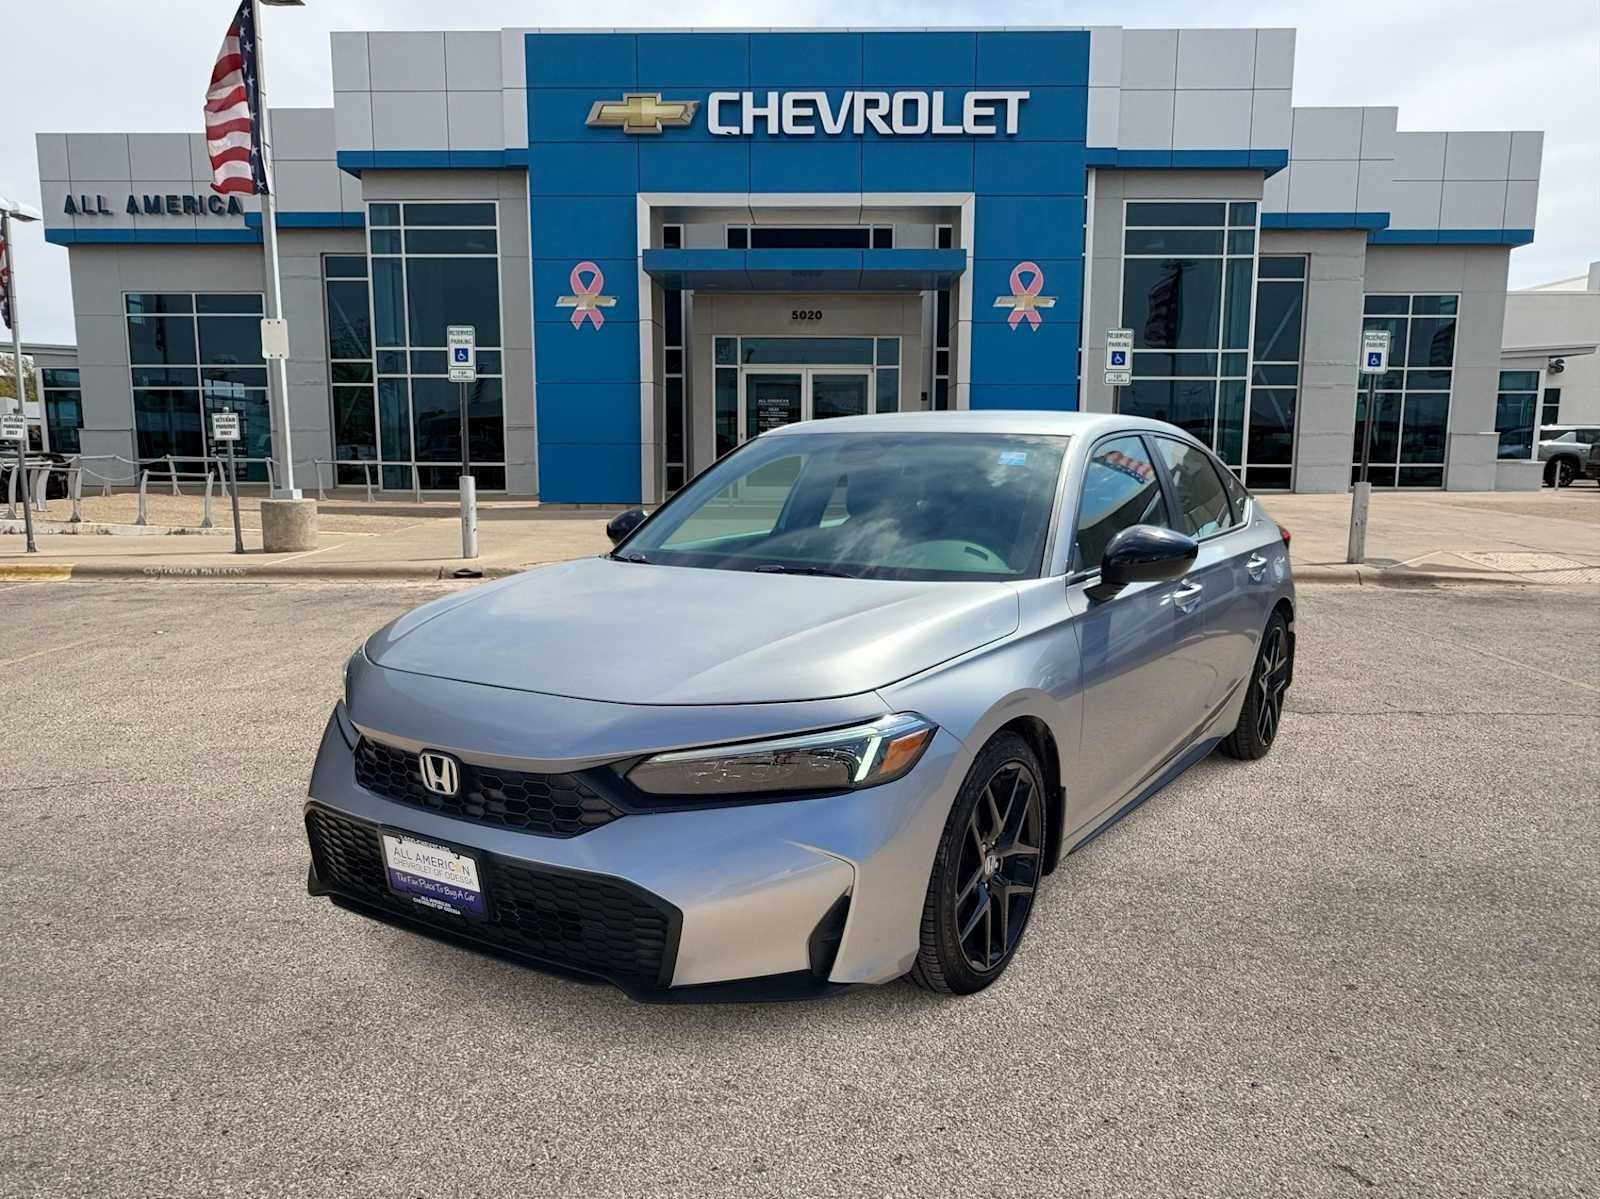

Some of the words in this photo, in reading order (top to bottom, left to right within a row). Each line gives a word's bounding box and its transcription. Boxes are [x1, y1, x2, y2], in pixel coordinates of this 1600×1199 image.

[708, 91, 1030, 135] CHEVROLET
[64, 194, 112, 215] ALL
[791, 310, 822, 320] 5020
[394, 847, 412, 861] ALL
[457, 890, 465, 900] A
